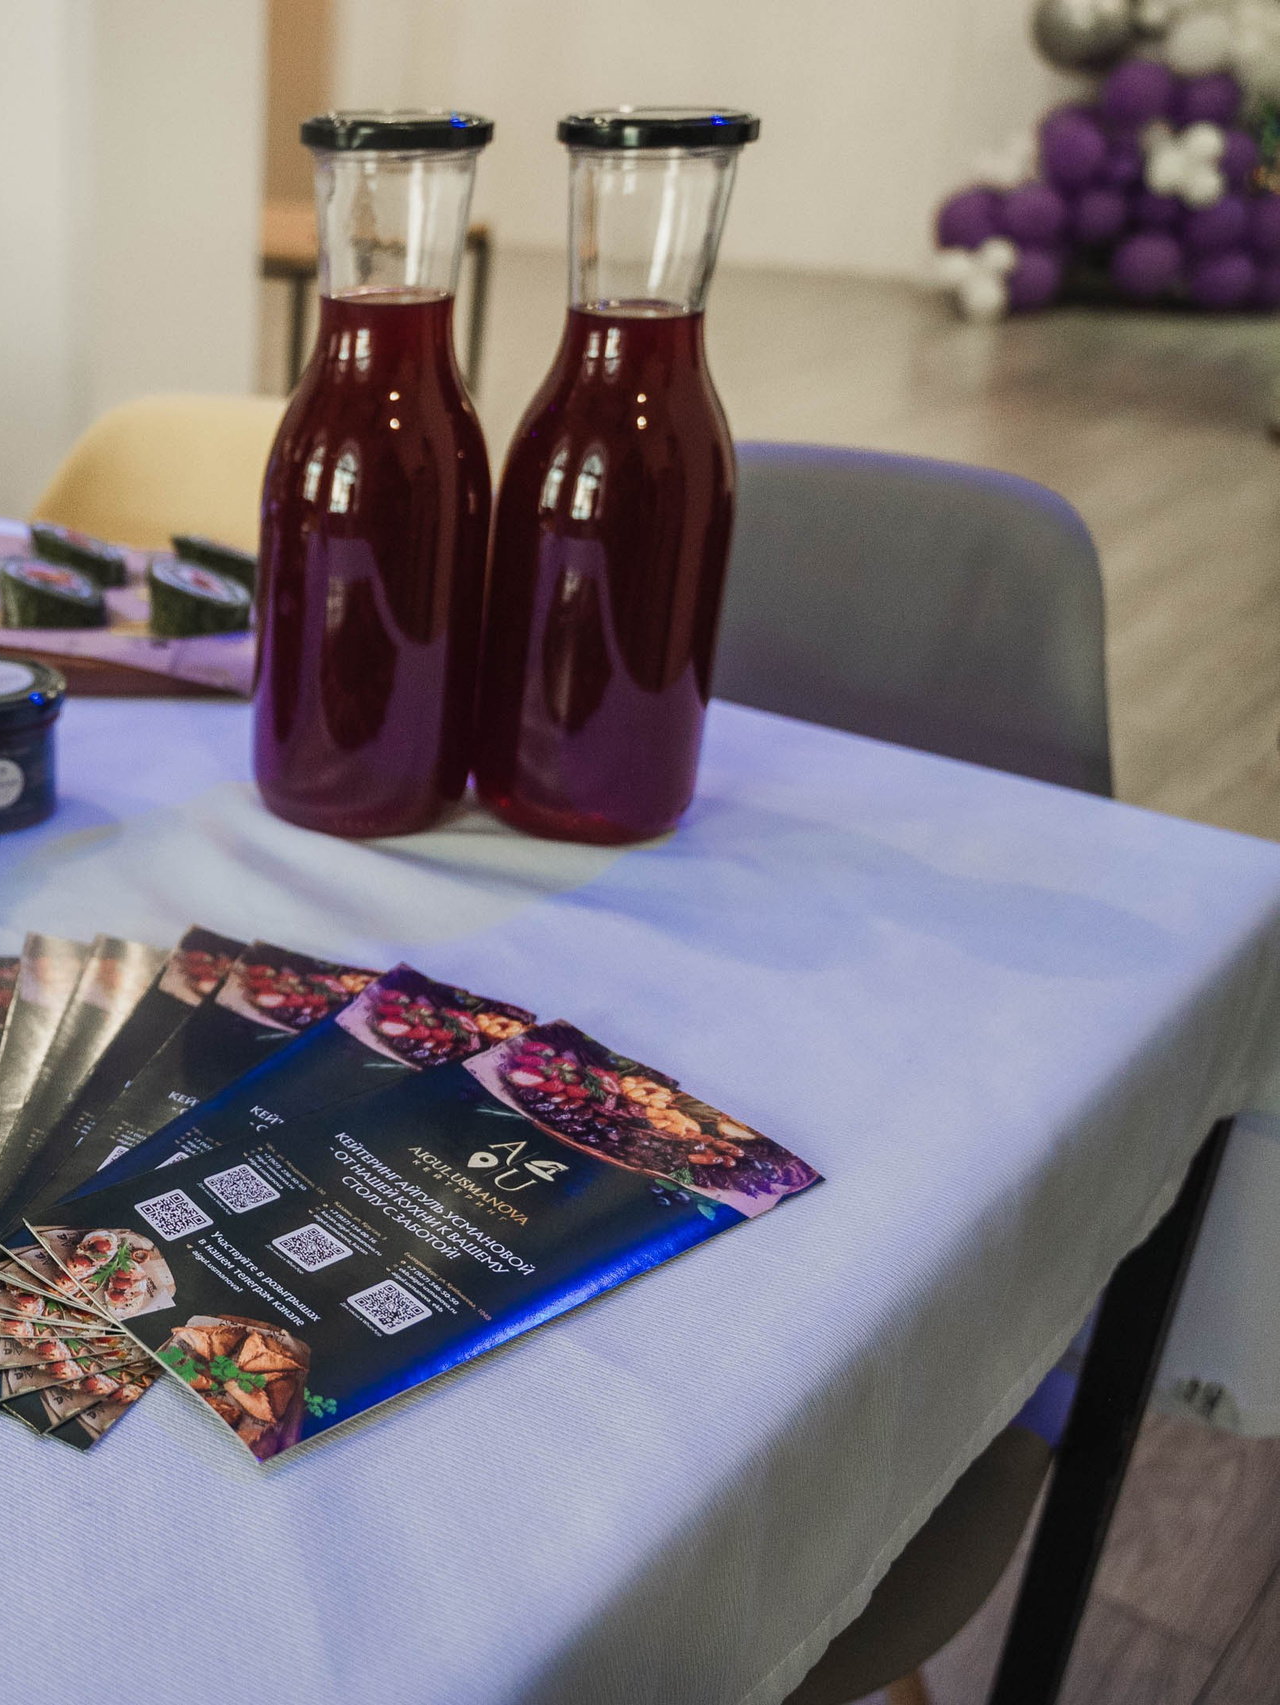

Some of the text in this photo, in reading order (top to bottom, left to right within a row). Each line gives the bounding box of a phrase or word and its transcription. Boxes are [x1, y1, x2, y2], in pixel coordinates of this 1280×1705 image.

[168, 1090, 200, 1107] КЕЙ
[409, 1148, 528, 1225] AIGUL.USMANOVA
[488, 1141, 527, 1167] A
[494, 1168, 538, 1191] U
[335, 1133, 535, 1275] КЕЙТЕРИНГ АЙГУЛЬ УСМАНОВОЙ
[335, 1151, 356, 1164] ОТ
[350, 1162, 399, 1198] НАШЕЙ
[393, 1196, 441, 1227] КУХНИ
[437, 1225, 452, 1235] К
[447, 1232, 509, 1272] ВАШЕМУ
[342, 1177, 461, 1259] СТОЛУ С ЗАБОТОЙ!
[413, 1160, 506, 1220] КЕЙТЕРИНГ
[192, 1251, 243, 1292] aigul.usmanova!
[205, 1245, 234, 1269] нашем
[234, 1269, 274, 1301] телеграм
[272, 1301, 304, 1326] канале
[211, 1231, 258, 1271] Участвуйте
[262, 1277, 320, 1321] розыгрышах
[414, 1269, 430, 1282] (937)
[428, 1281, 459, 1305] 346-50-50
